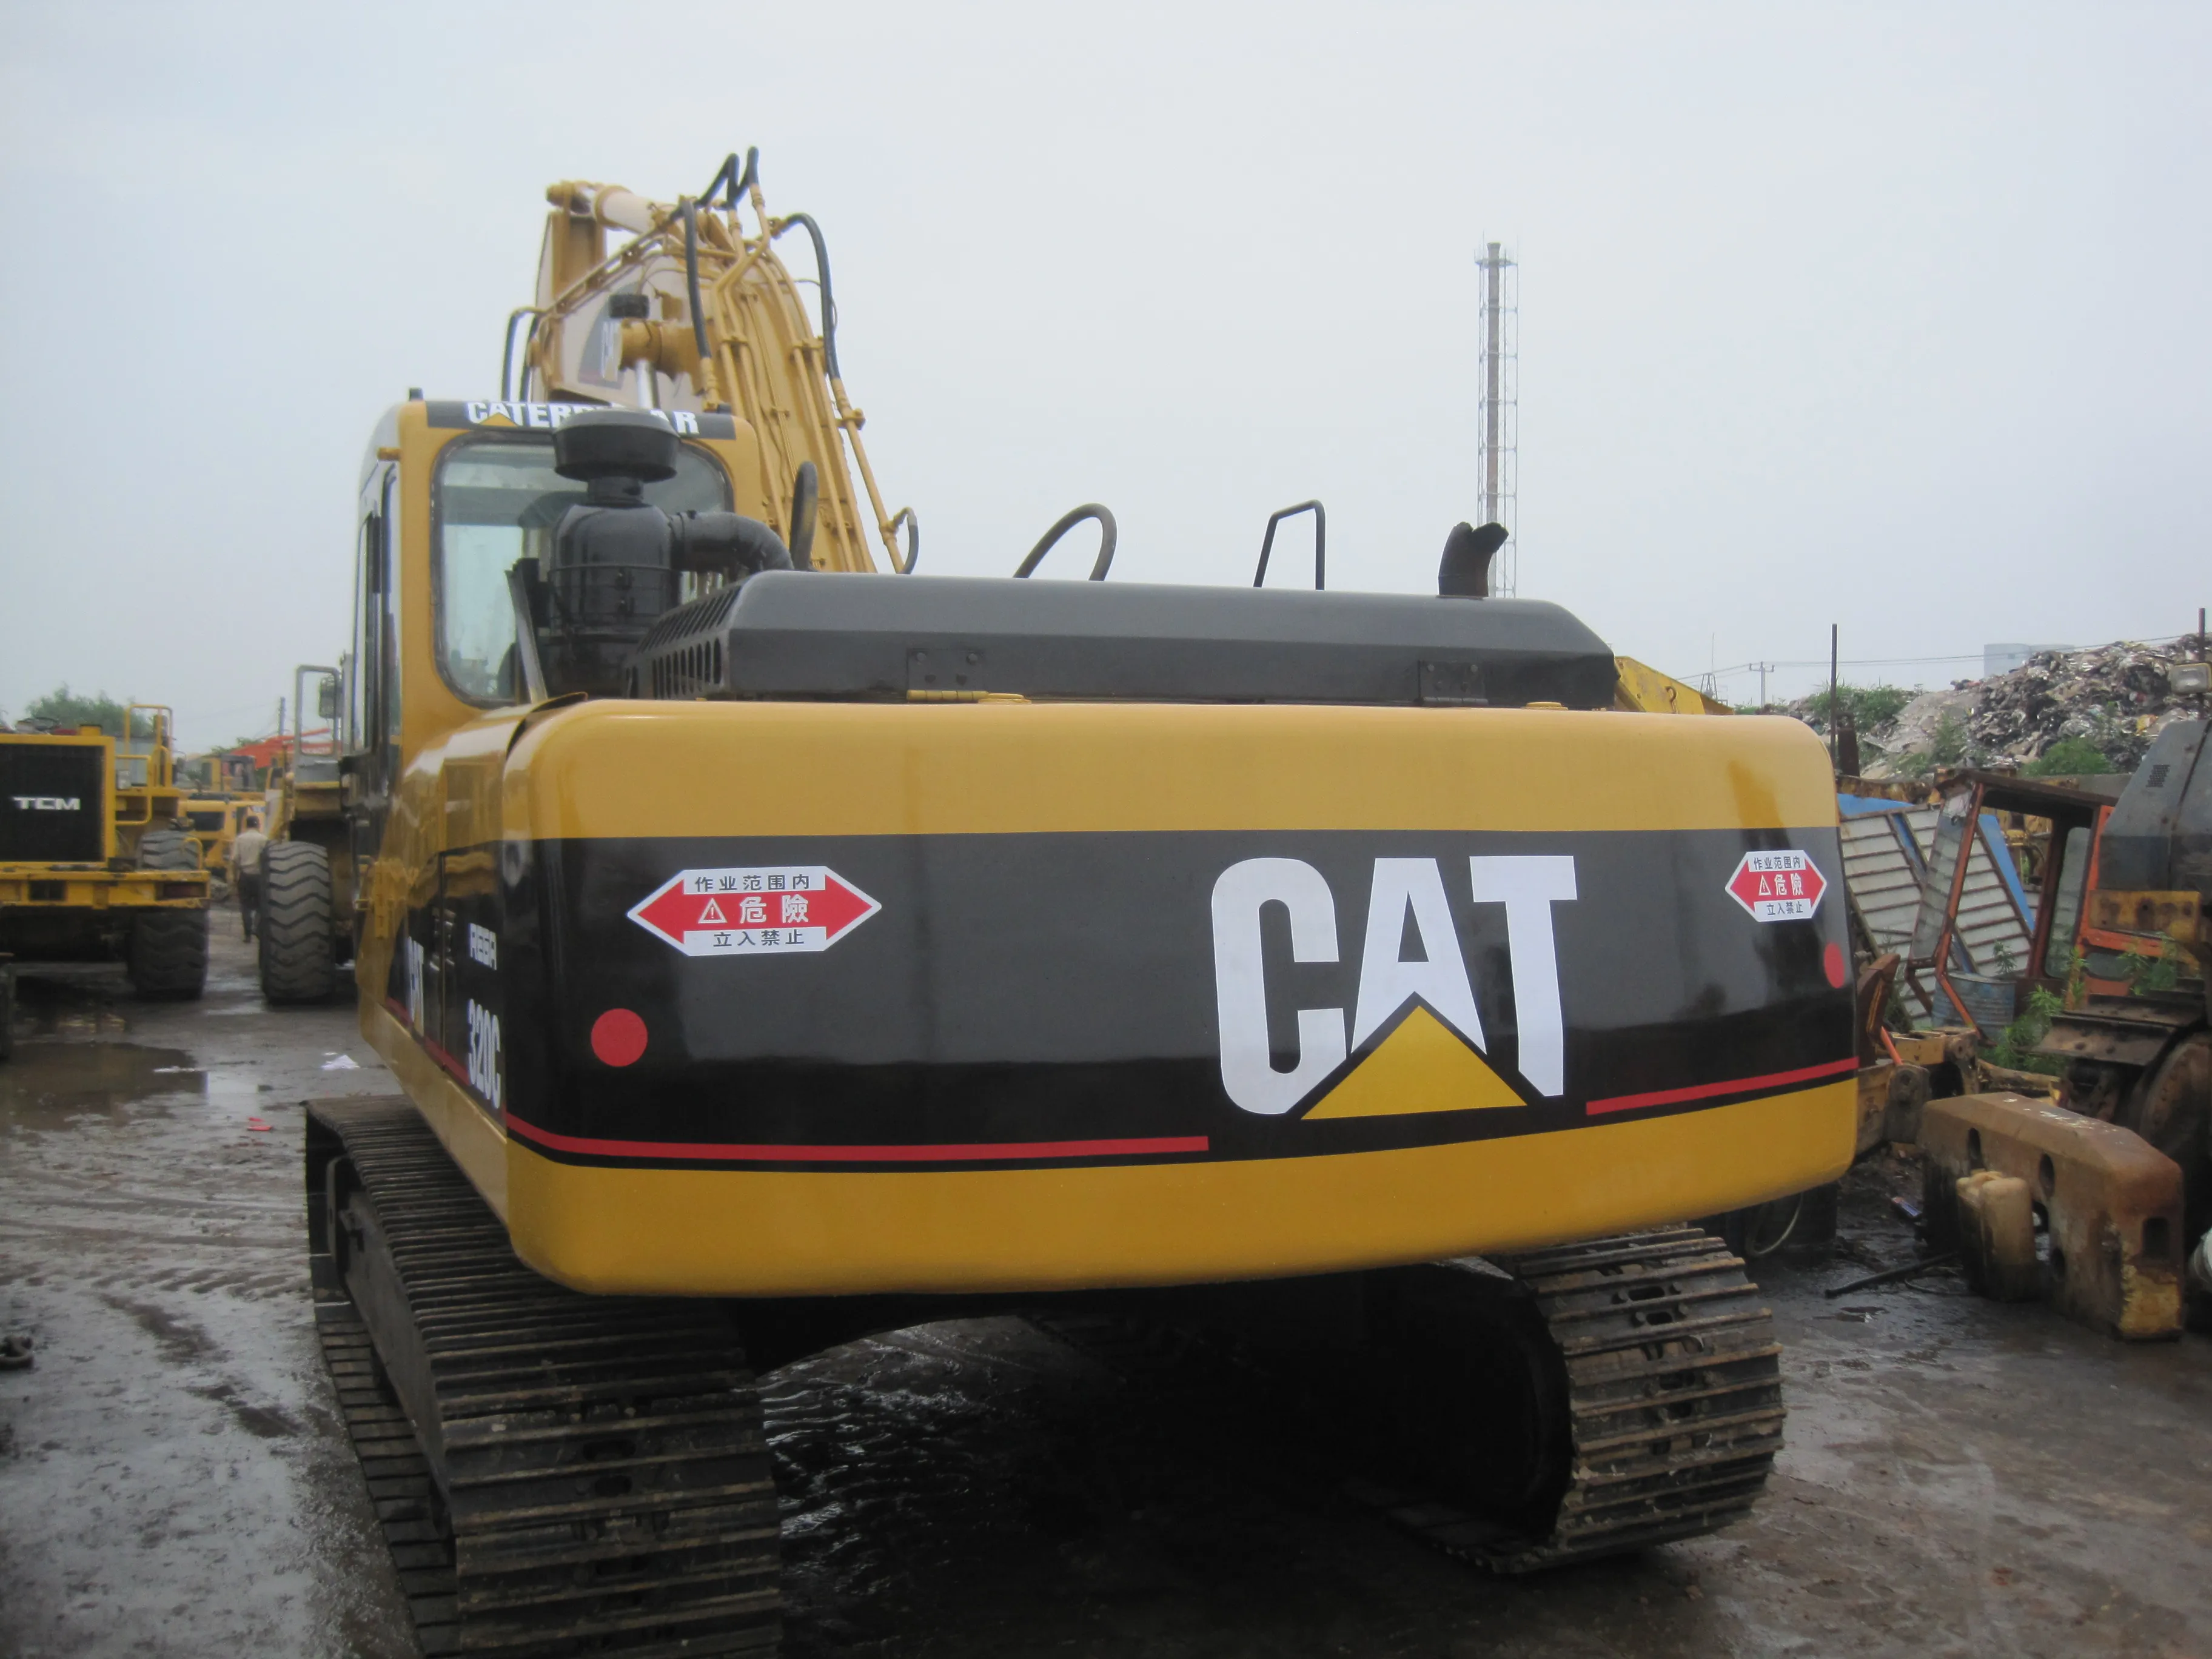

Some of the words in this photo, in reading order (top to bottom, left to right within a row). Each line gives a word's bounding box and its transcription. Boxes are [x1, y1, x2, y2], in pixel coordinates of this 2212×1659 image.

[466, 401, 699, 435] CATERR
[13, 796, 81, 810] TCM
[1754, 856, 1801, 871] 作业范围内
[694, 873, 810, 893] 作业范围内
[739, 893, 809, 923] 危險
[1766, 901, 1804, 916] 立入禁止
[713, 929, 805, 947] 立入禁止
[1212, 856, 1577, 1114] CAT
[469, 998, 501, 1109] 320C
